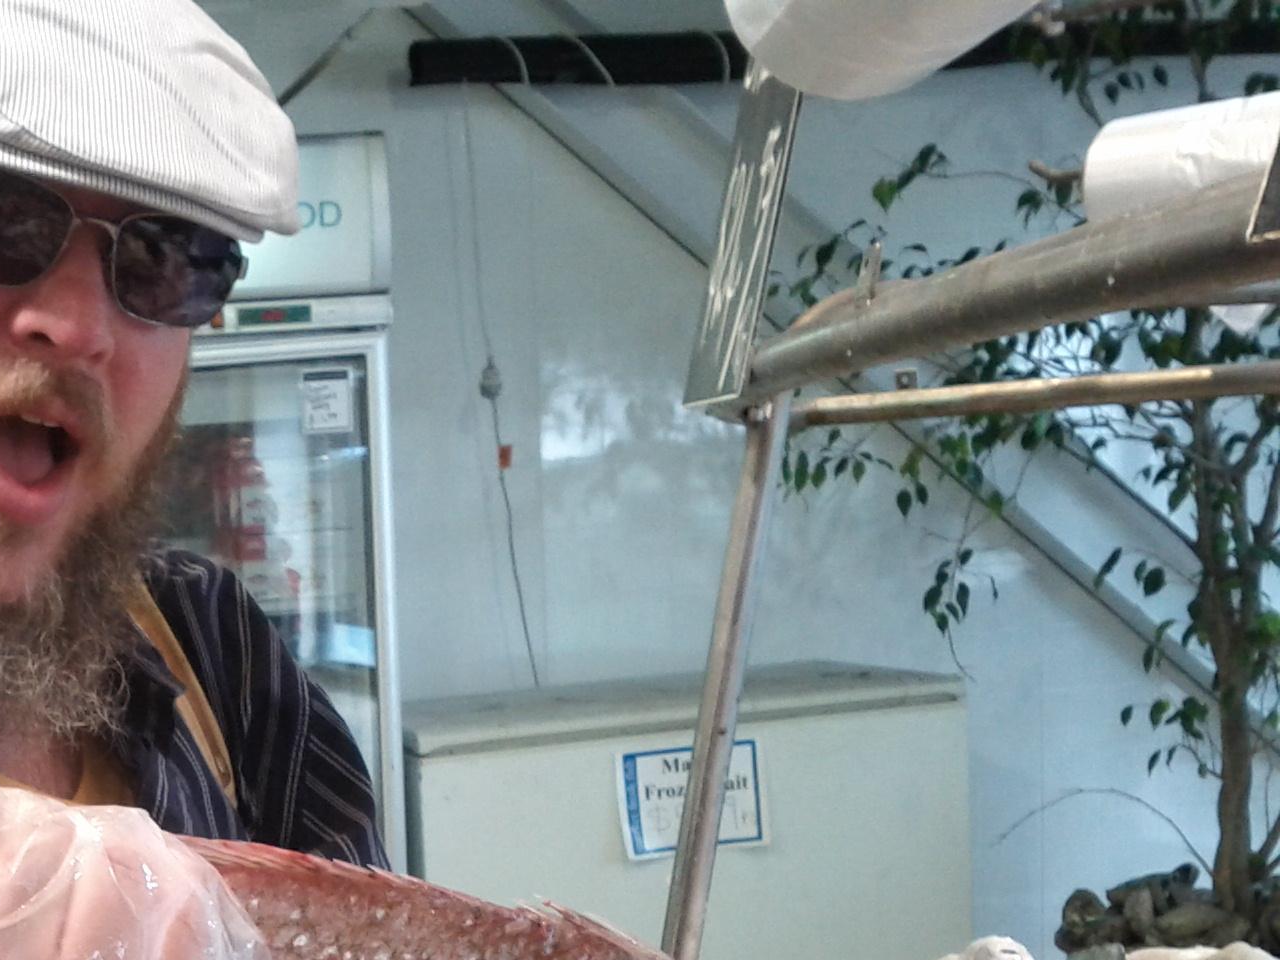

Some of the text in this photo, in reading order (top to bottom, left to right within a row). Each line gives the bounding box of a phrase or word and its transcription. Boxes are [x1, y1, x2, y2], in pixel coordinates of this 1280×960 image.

[297, 201, 342, 228] OD
[662, 758, 692, 774] Ma
[644, 775, 748, 801] Froz ait
